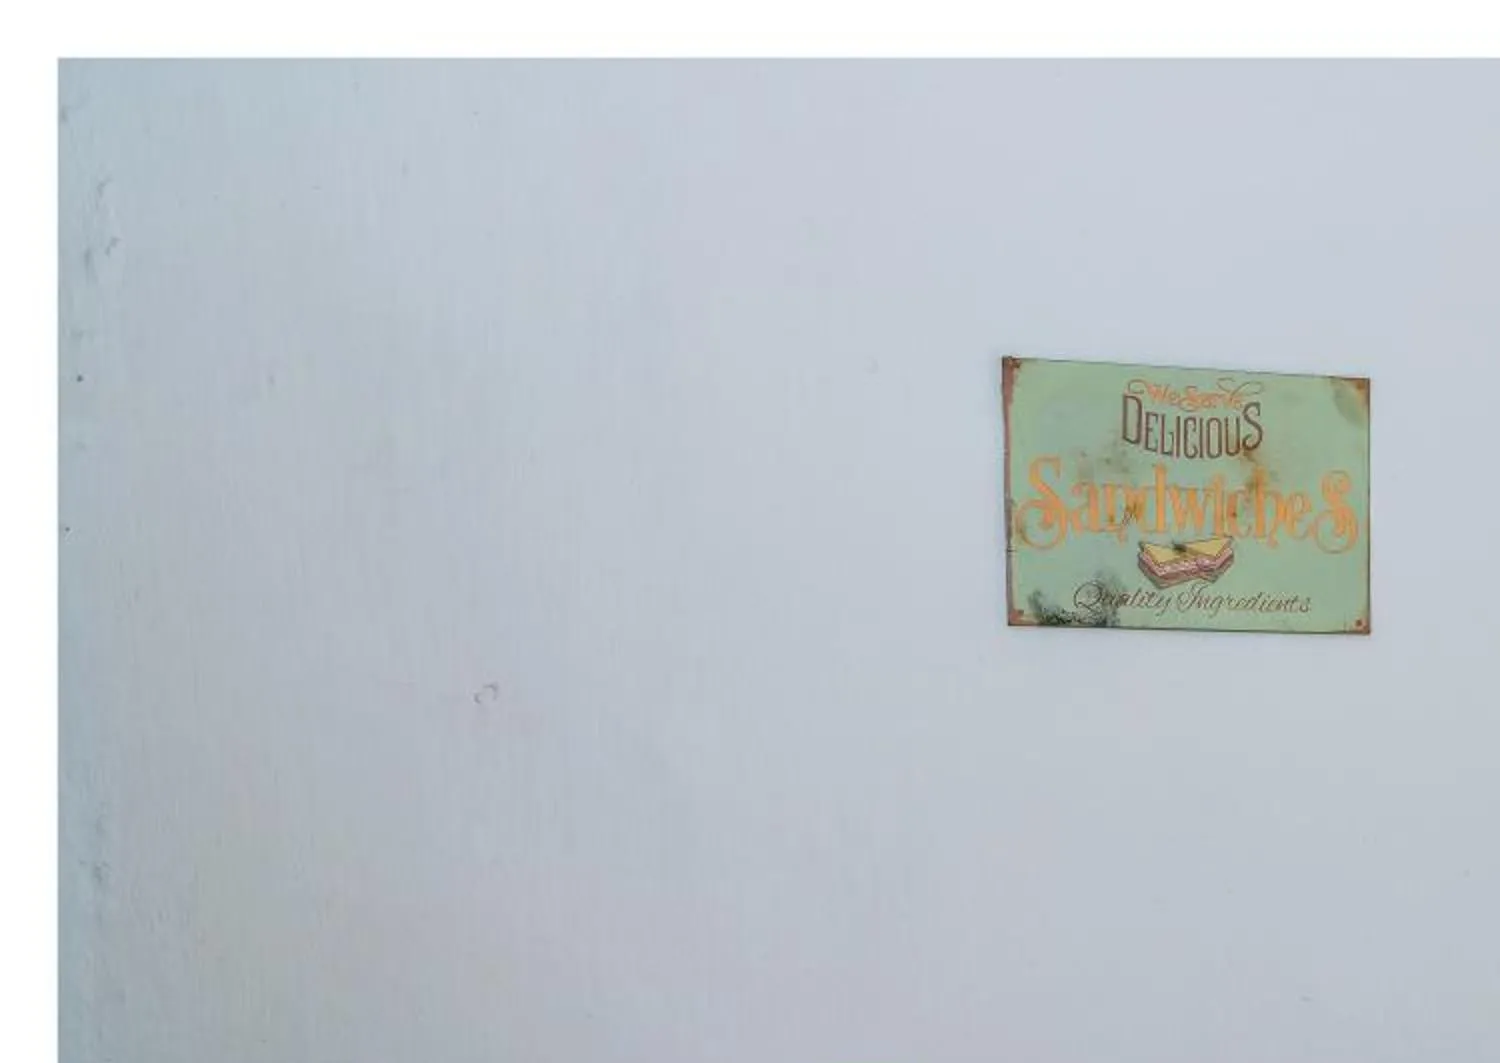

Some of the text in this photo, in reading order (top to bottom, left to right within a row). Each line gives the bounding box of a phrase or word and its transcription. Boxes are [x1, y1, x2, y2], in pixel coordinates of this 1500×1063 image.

[1121, 394, 1263, 460] DELICIOUS
[1073, 581, 1312, 618] Quality Ingredients
